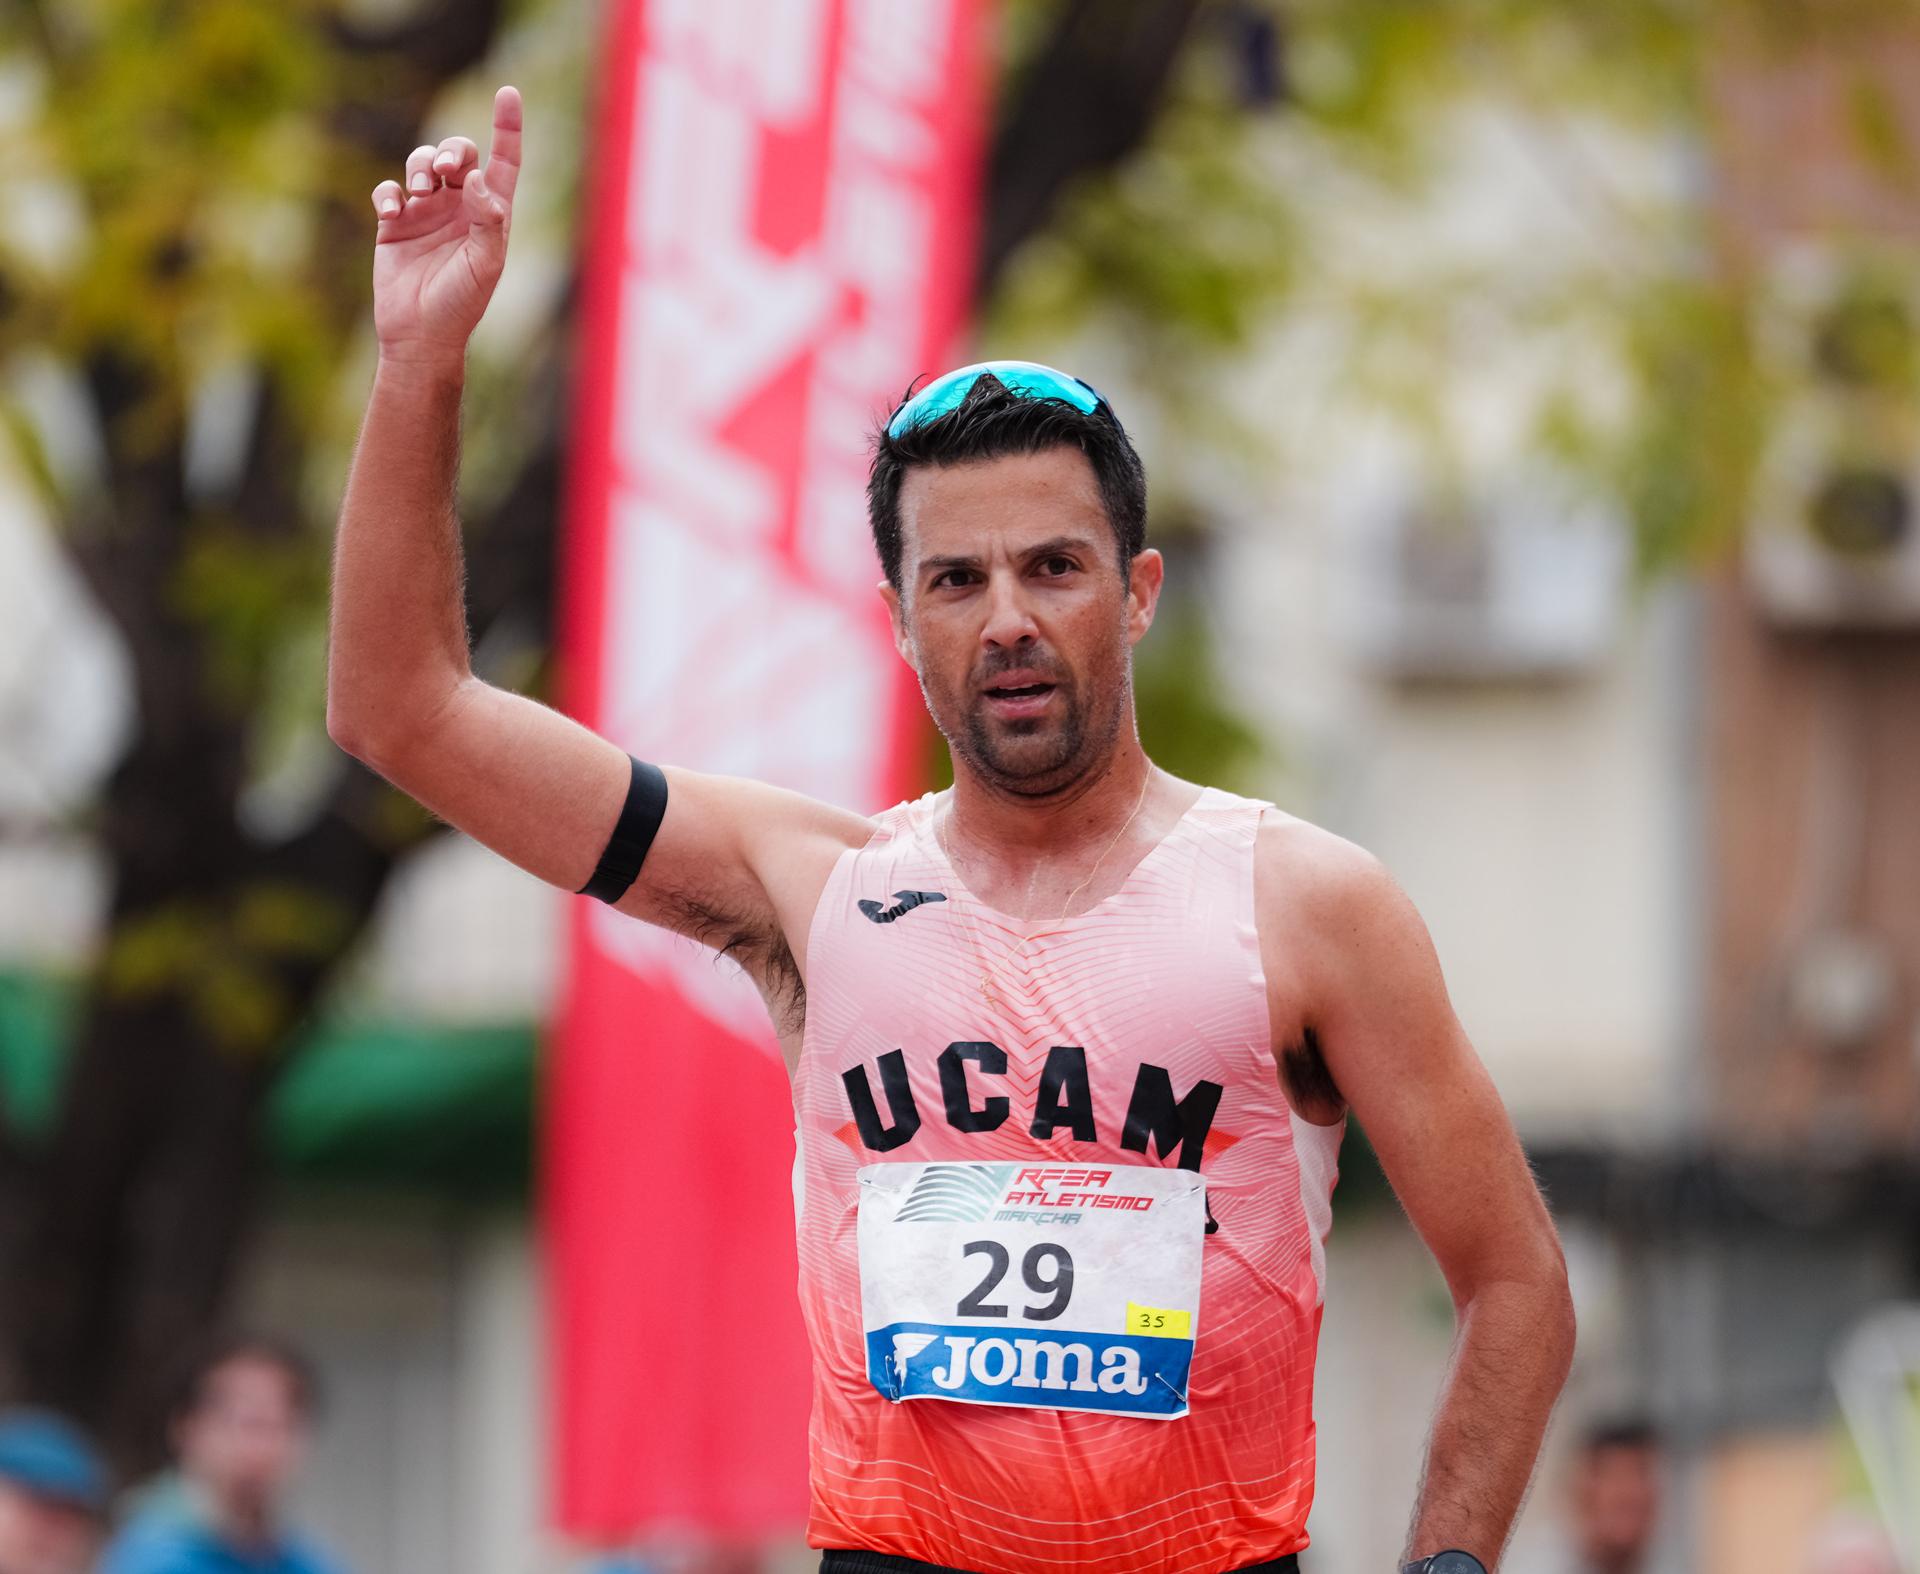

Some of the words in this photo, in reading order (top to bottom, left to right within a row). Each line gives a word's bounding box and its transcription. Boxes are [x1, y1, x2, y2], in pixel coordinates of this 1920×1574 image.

[841, 1041, 1223, 1173] UCAM
[1014, 1168, 1112, 1191] RFEA
[1004, 1191, 1154, 1211] ATLETISMO
[993, 1210, 1082, 1225] MARCHA
[956, 1240, 1074, 1321] 29
[1140, 1313, 1165, 1328] 35
